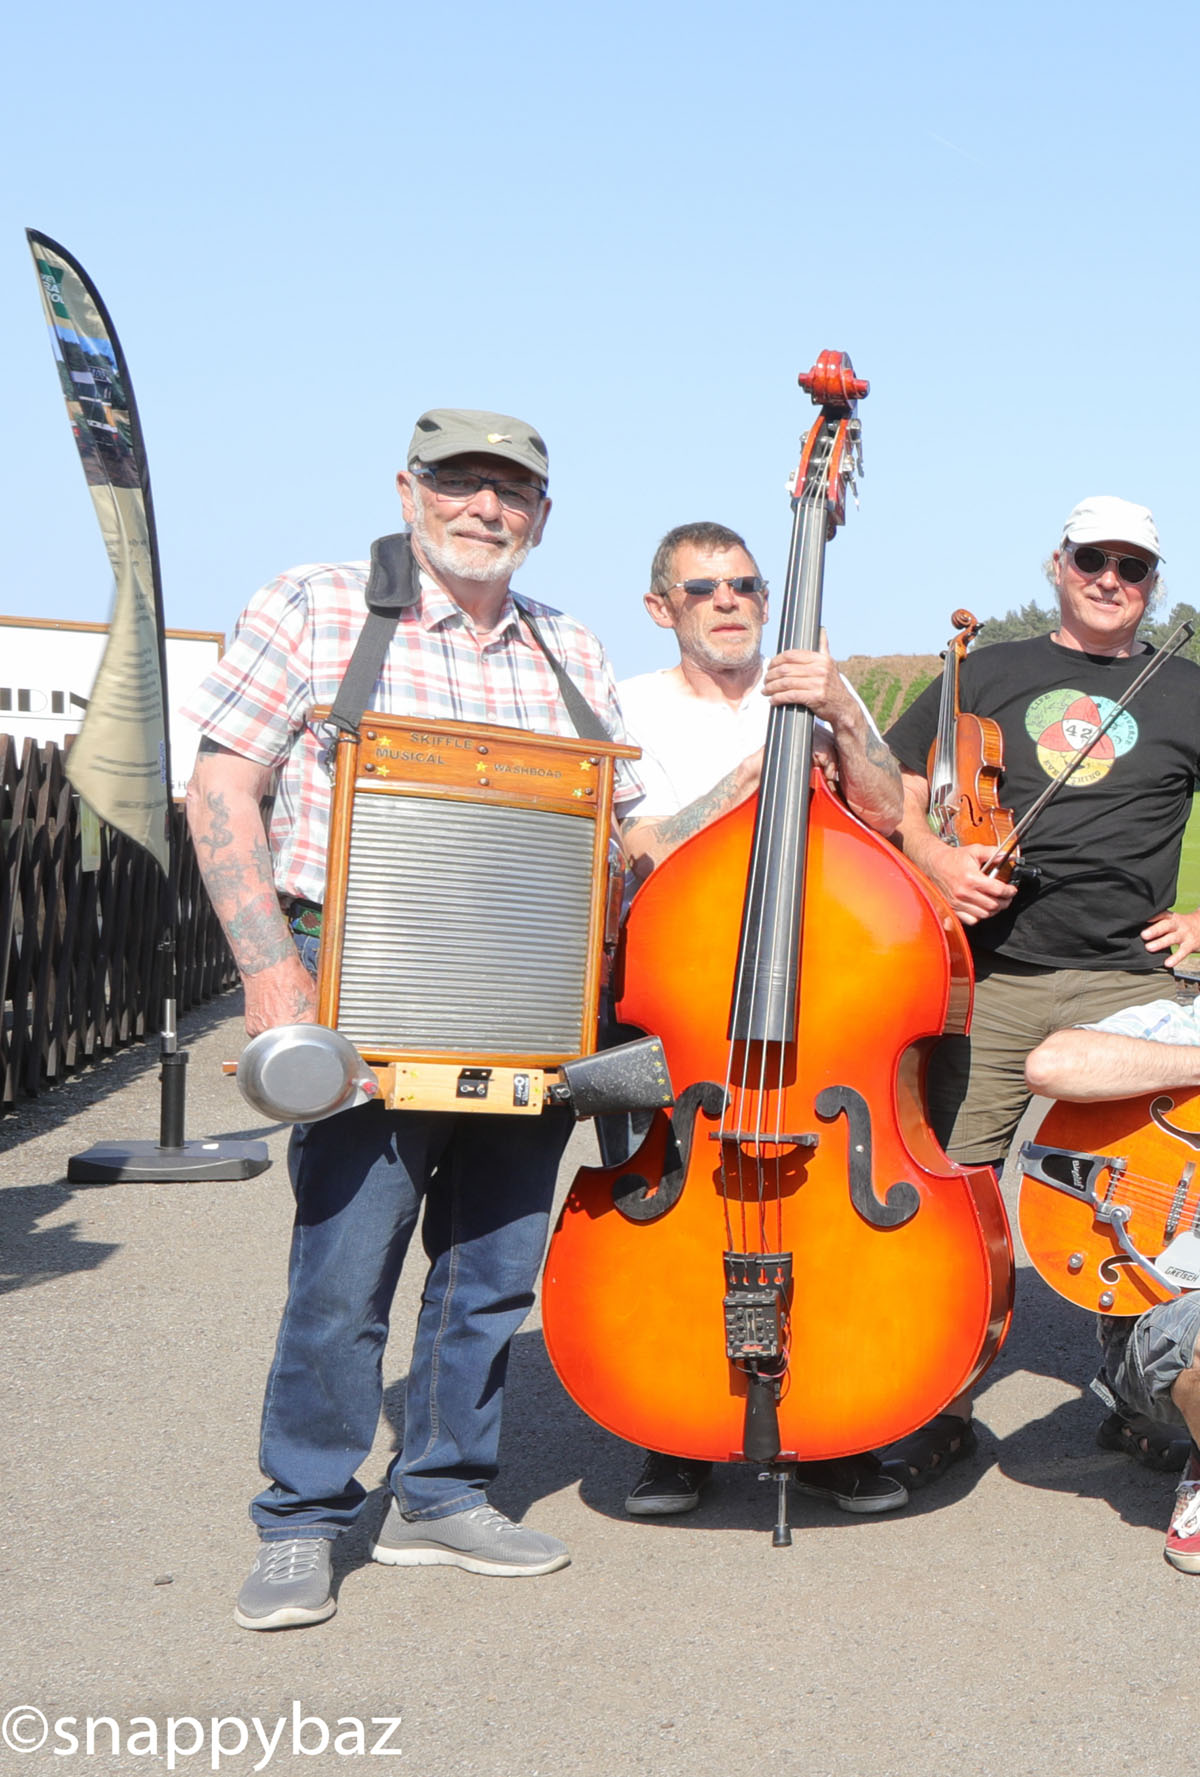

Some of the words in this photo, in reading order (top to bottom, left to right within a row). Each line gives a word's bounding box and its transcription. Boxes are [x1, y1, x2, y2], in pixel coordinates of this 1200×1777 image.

[1065, 724, 1093, 740] 42
[410, 732, 473, 750] SKIFFLE
[376, 748, 446, 765] MUSICAL
[1165, 1266, 1199, 1282] GRETSCH
